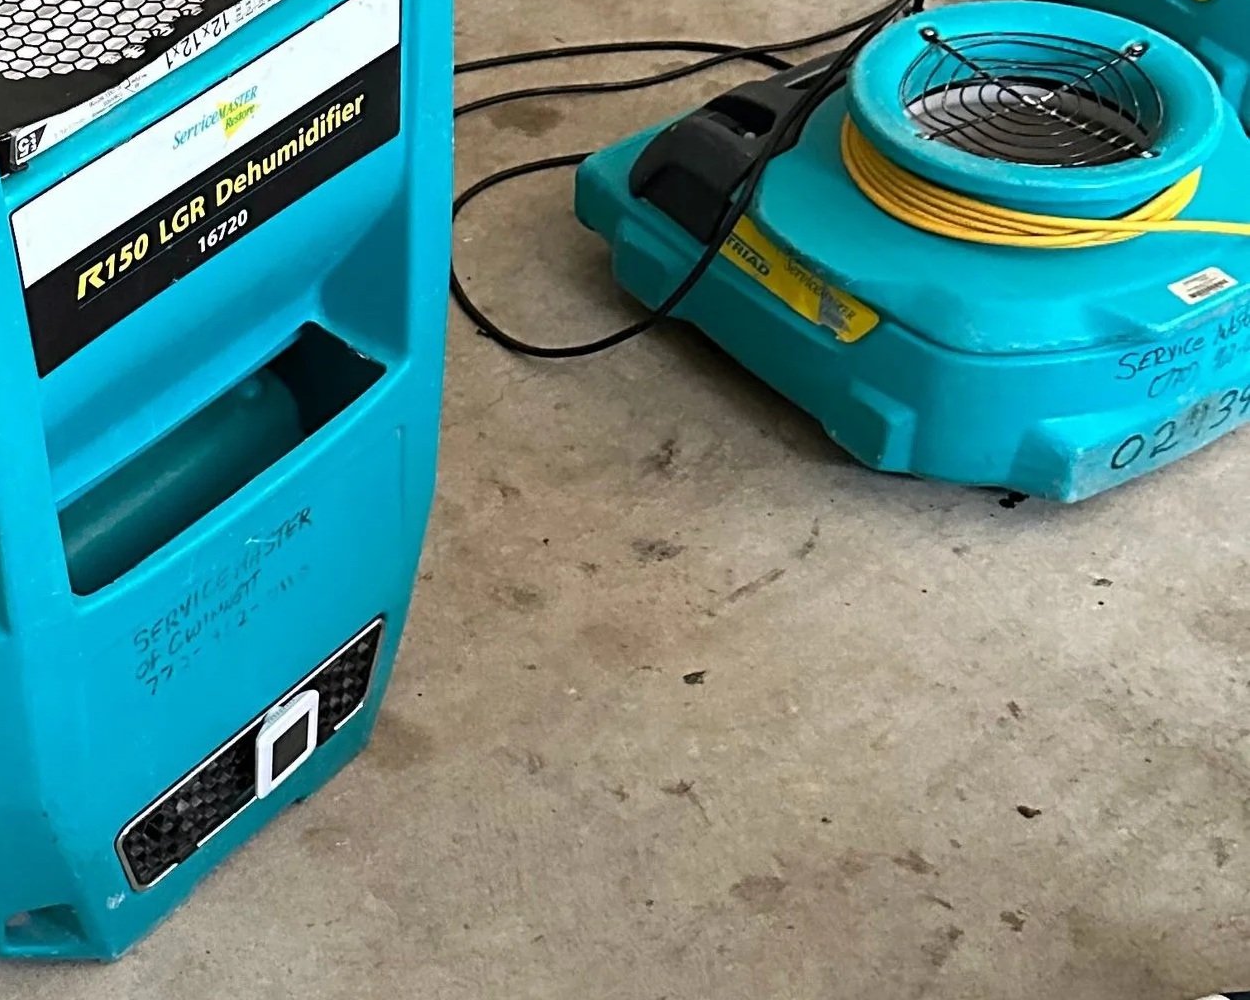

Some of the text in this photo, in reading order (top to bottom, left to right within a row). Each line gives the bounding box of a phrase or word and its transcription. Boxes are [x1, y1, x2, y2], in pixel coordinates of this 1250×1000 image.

[173, 85, 258, 150] ServiceMASTER
[76, 232, 149, 301] R150
[158, 195, 206, 245] LGR
[216, 93, 366, 207] Dehumidifier
[197, 209, 249, 254] 16720
[726, 235, 770, 277] TRIAD
